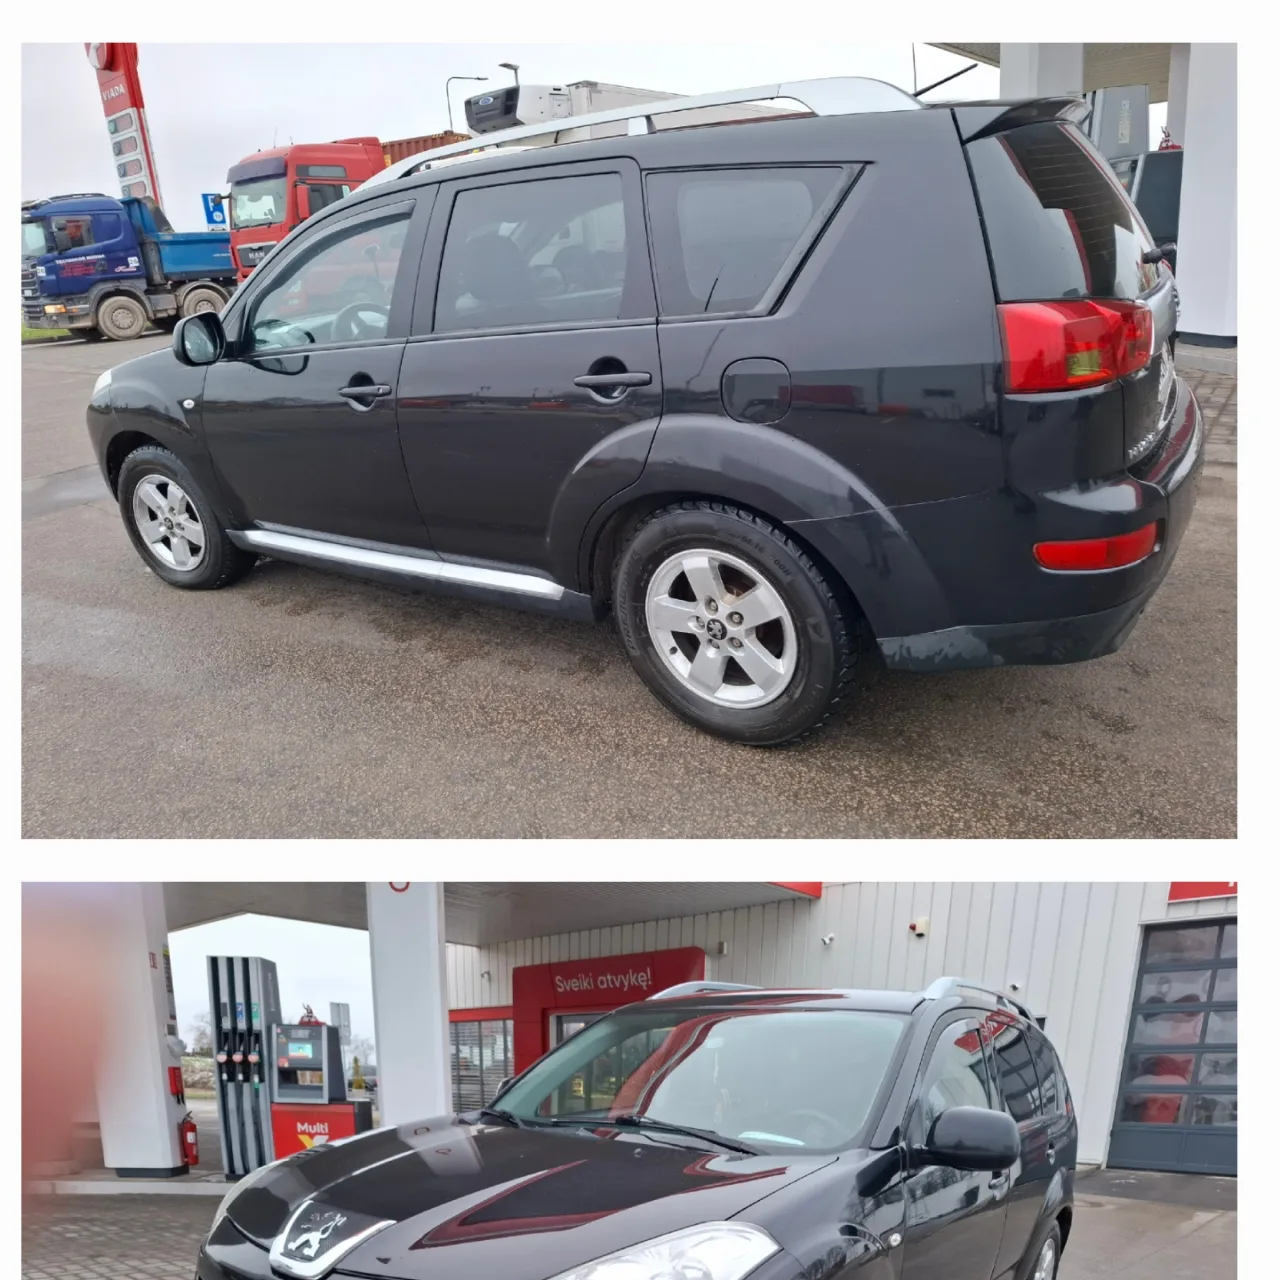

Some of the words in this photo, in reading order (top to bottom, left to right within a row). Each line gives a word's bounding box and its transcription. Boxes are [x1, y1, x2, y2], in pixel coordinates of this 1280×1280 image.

[102, 84, 125, 101] VIADA
[249, 251, 265, 260] MAN
[555, 972, 594, 992] Sveiki
[597, 967, 652, 991] atvykę!
[296, 1121, 329, 1133] Multi
